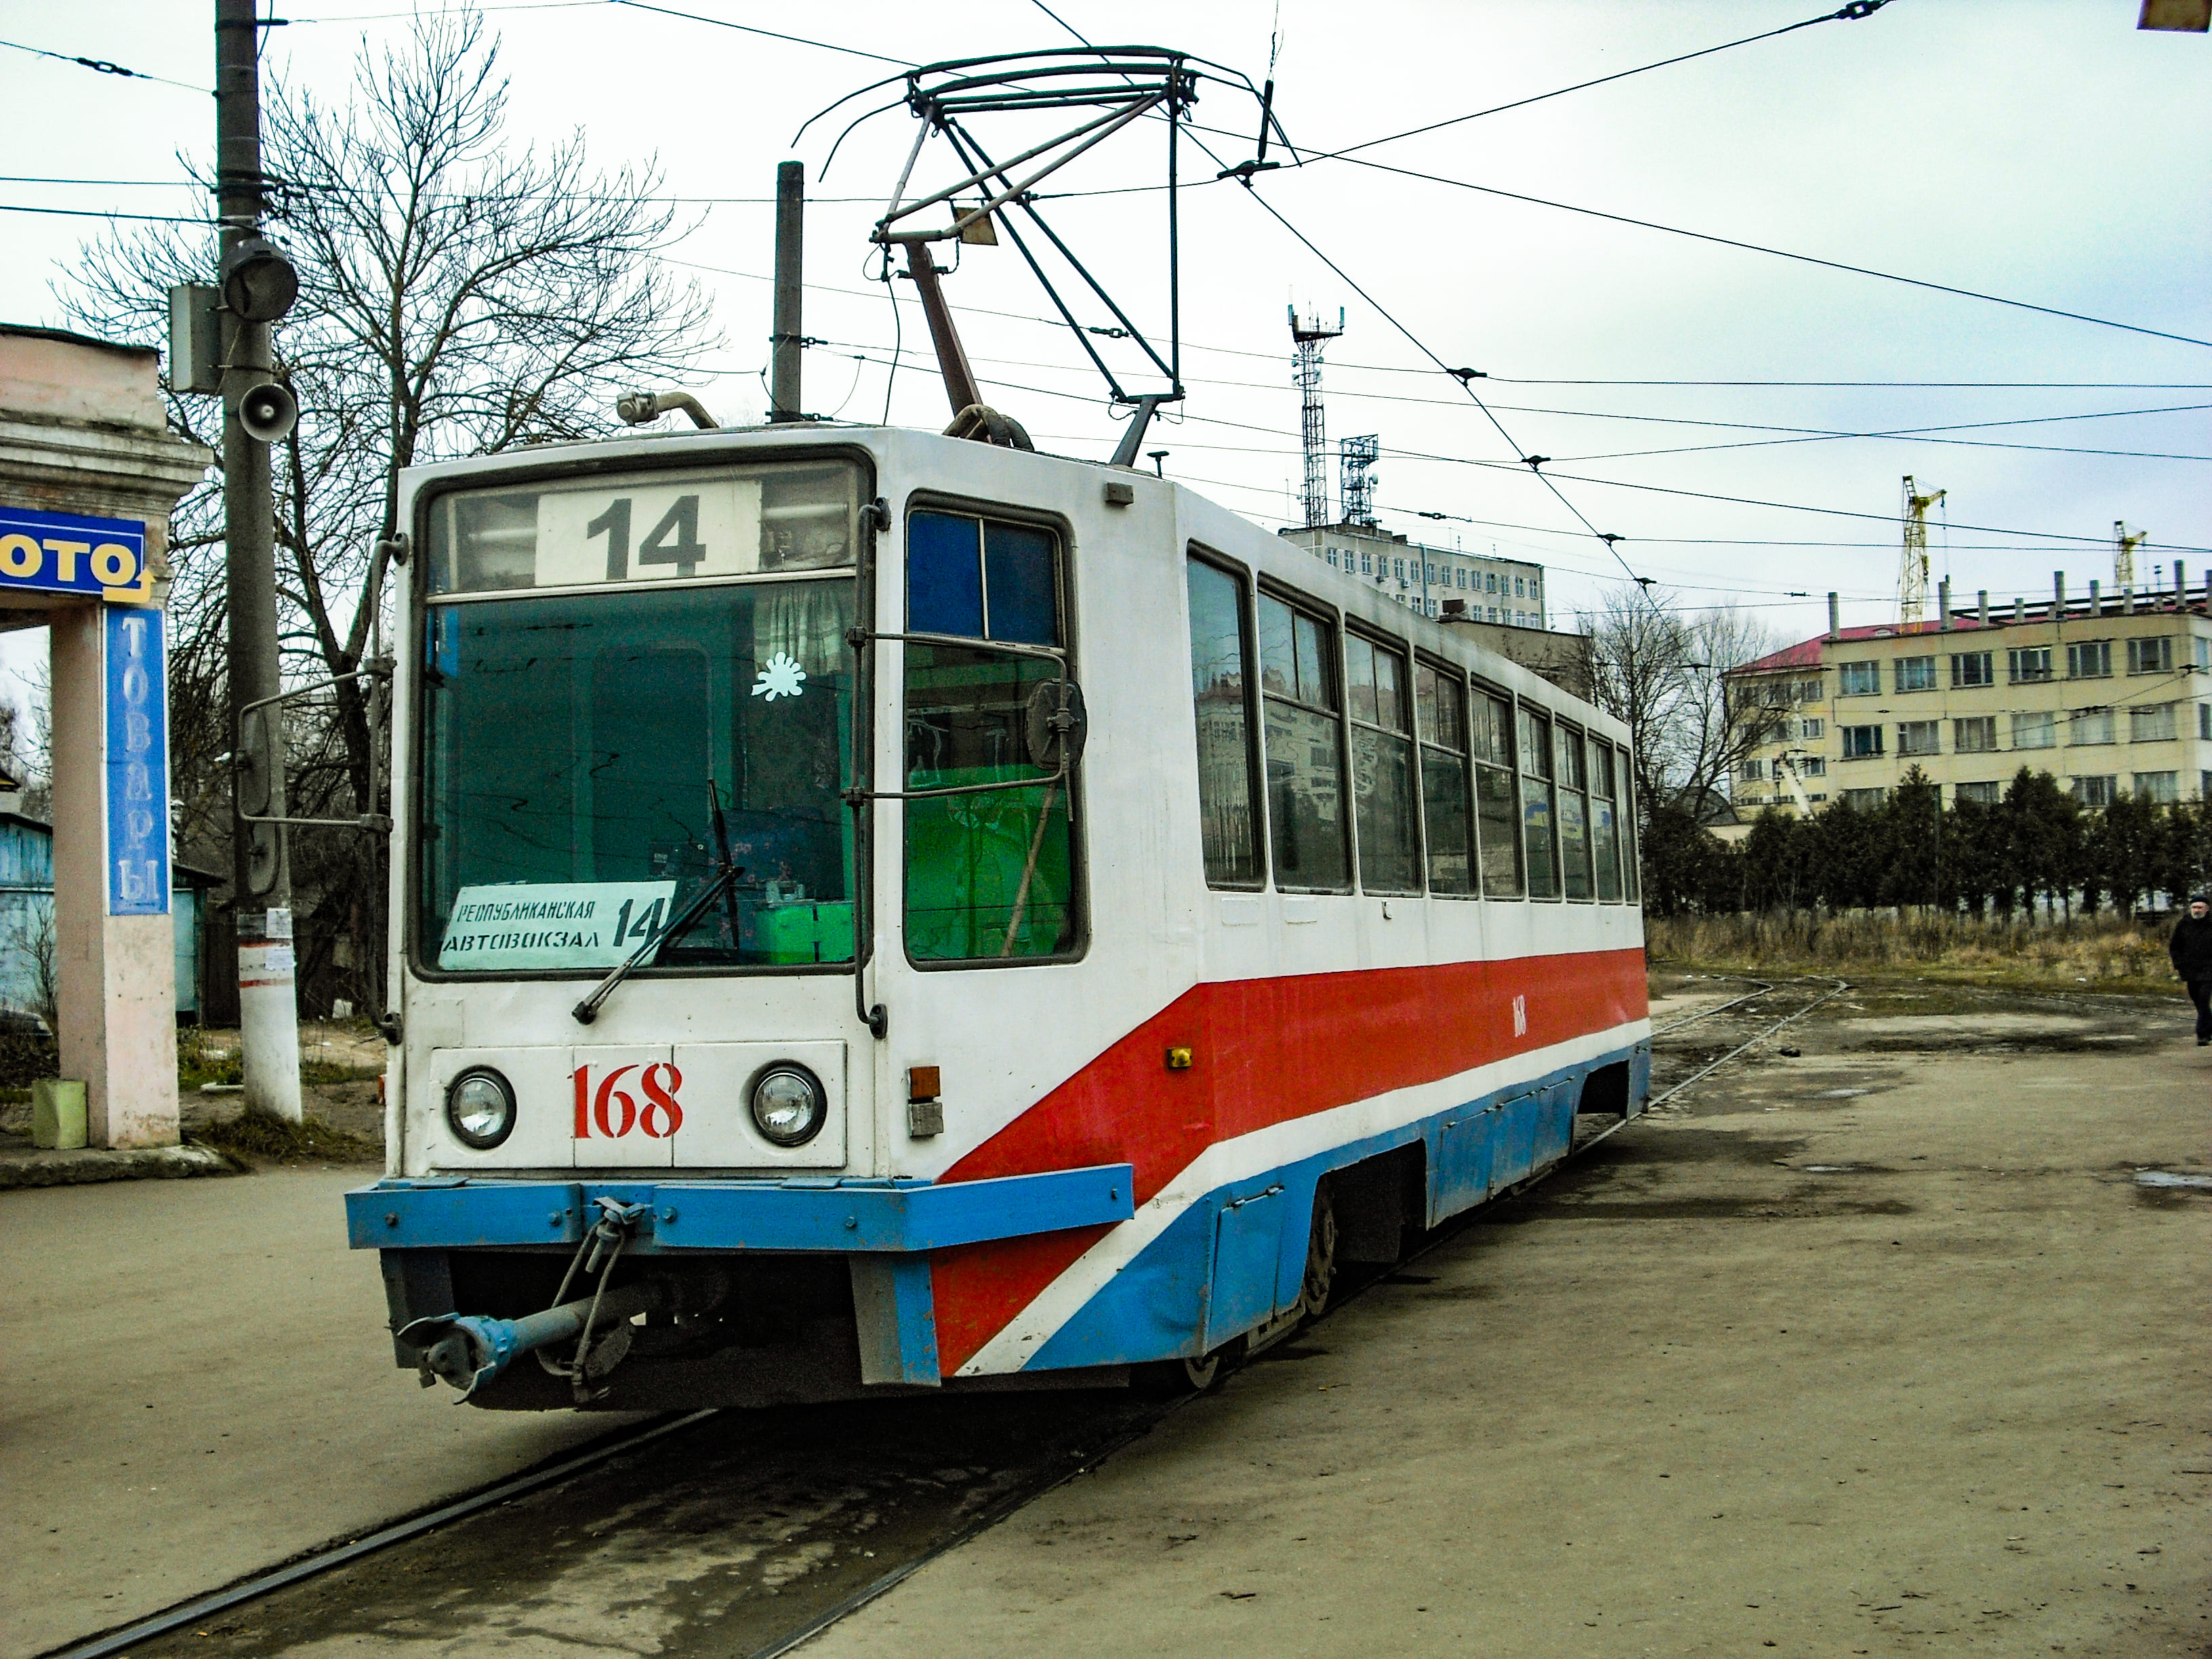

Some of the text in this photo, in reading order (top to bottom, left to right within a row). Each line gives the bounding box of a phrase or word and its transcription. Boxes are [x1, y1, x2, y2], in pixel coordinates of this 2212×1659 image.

[587, 495, 707, 581] 14
[119, 617, 160, 900] ТОВАРЫ
[443, 931, 599, 952] АВТОВОКЗАЛ
[613, 897, 666, 947] 14
[567, 1062, 683, 1140] 168
